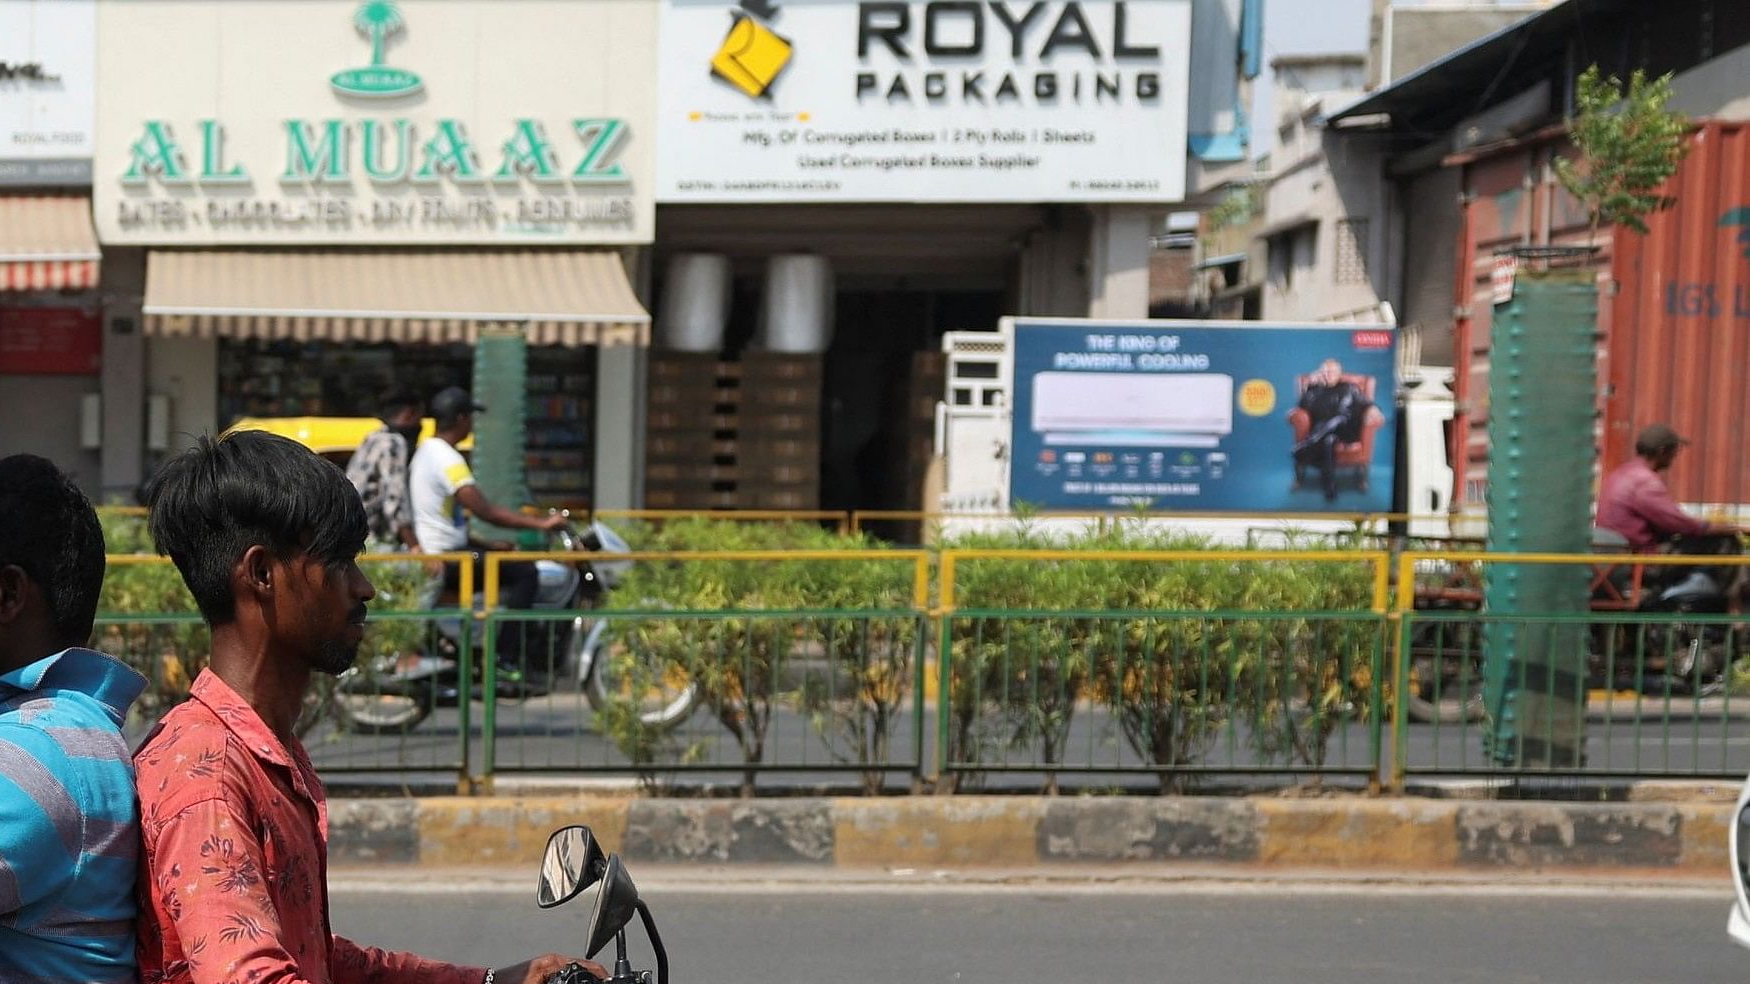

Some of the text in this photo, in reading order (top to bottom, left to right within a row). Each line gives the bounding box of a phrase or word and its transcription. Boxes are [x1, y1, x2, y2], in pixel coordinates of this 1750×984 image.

[858, 1, 1159, 58] ROYAL
[856, 73, 1161, 99] PACKAGING
[120, 119, 632, 186] AL MUAAZ
